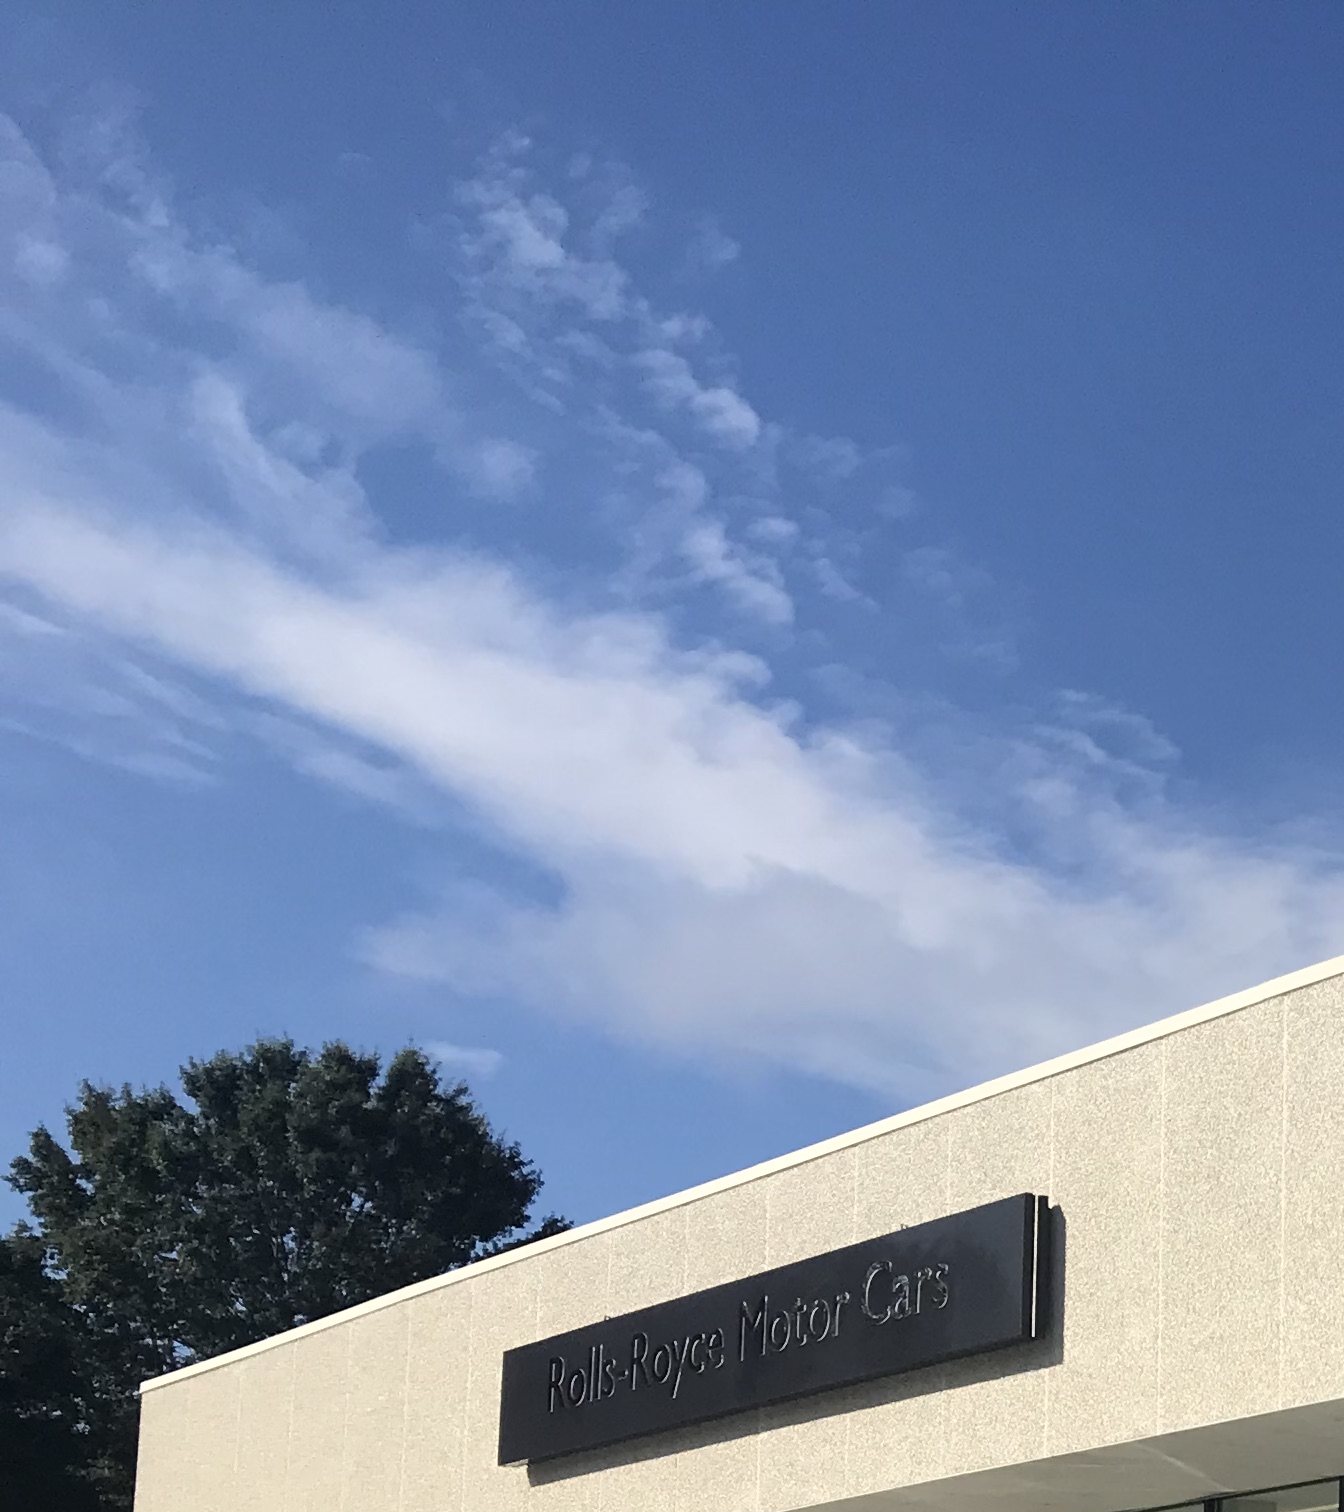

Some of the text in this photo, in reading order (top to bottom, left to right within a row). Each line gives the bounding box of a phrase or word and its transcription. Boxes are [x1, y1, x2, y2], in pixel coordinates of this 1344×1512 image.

[548, 1259, 950, 1415] Rolls-Royce Motor Cars
